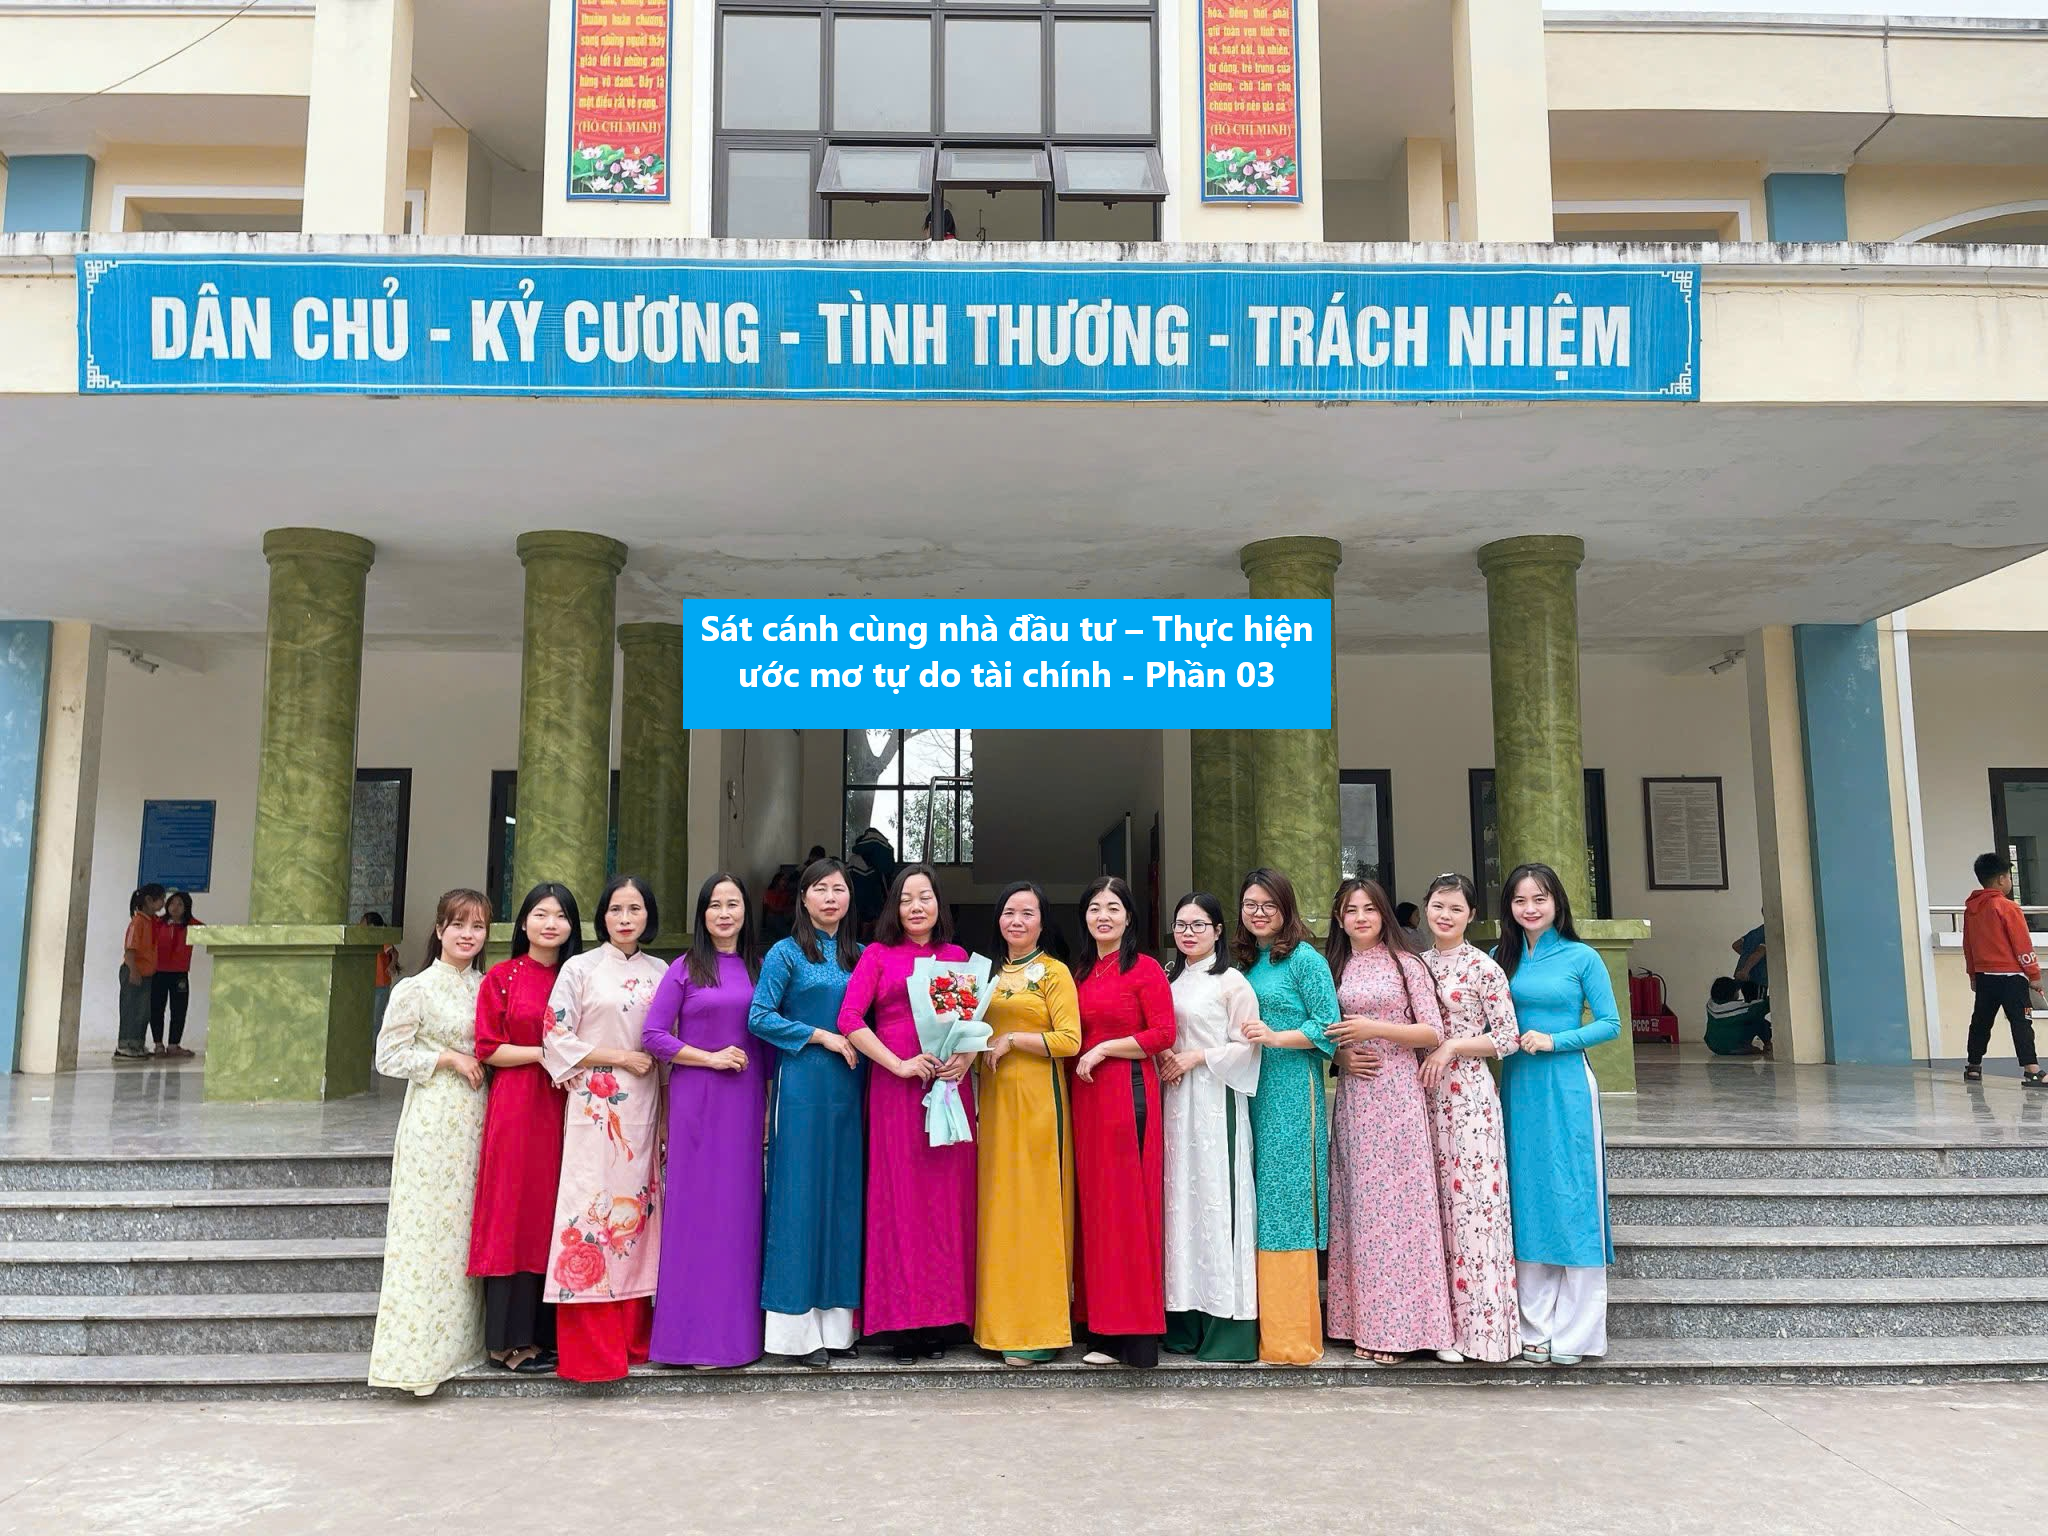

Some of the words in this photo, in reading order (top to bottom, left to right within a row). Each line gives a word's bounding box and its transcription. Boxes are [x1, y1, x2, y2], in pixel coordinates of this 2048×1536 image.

[151, 282, 269, 361] DÂN
[292, 276, 409, 362] CHỦ
[431, 328, 450, 342] -
[471, 277, 544, 362] KỶ
[564, 293, 759, 364] CƯƠNG
[780, 332, 800, 344] -
[818, 291, 947, 365] TÌNH
[966, 297, 1189, 367] THƯƠNG
[1210, 334, 1229, 347] -
[1248, 292, 1428, 367] TRÁCH
[1449, 293, 1630, 381] NHIỆM
[1632, 1019, 1650, 1032] PCCC
